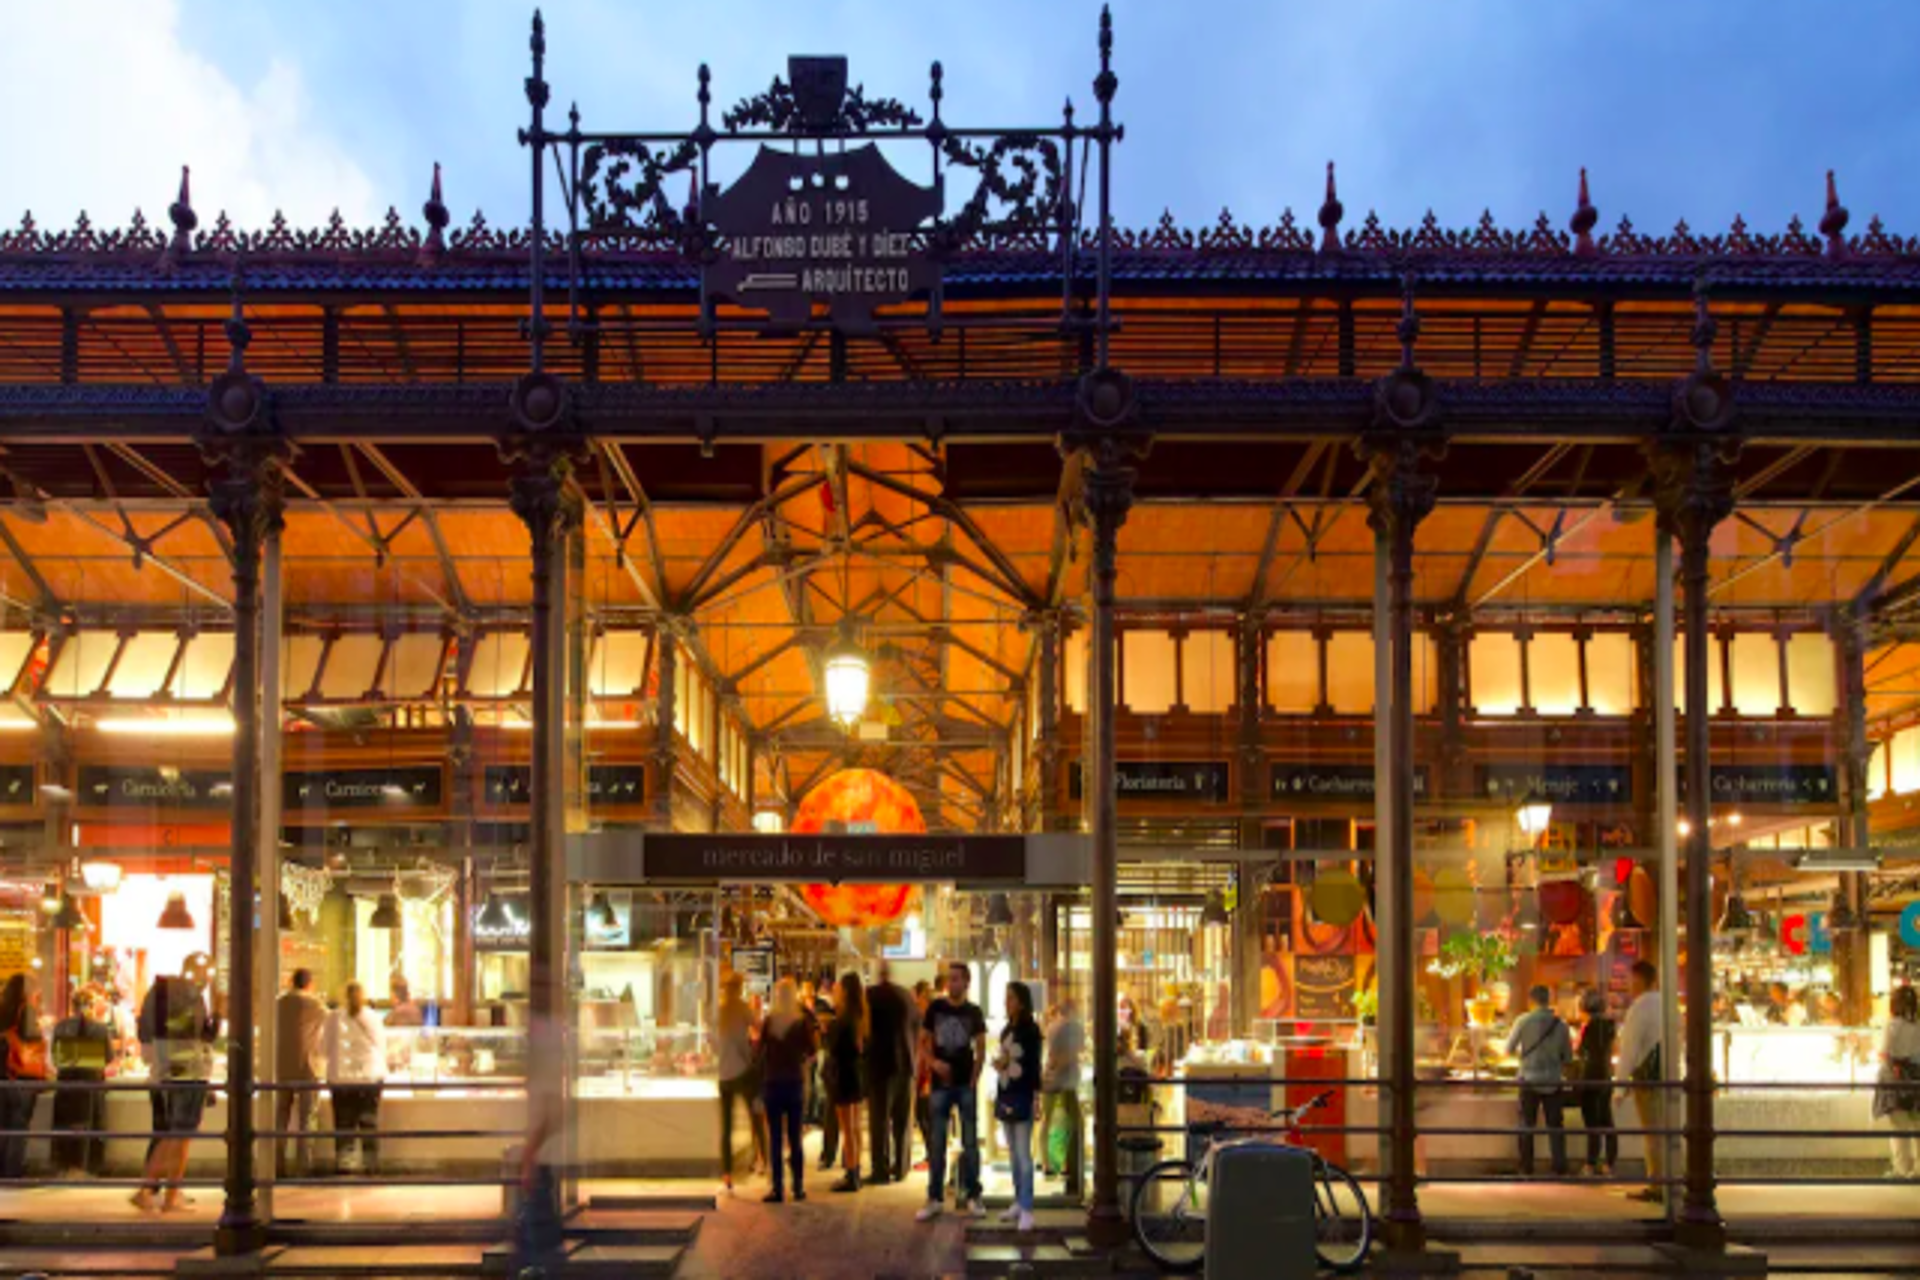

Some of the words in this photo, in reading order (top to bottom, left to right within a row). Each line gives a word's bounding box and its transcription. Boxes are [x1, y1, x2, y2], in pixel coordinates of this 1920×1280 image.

[771, 196, 811, 225] AÑO
[825, 198, 869, 224] 1915
[732, 235, 807, 260] ALFONSO
[859, 234, 867, 258] Y
[702, 840, 804, 868] mercado
[809, 840, 837, 868] de
[842, 849, 882, 869] san
[887, 841, 967, 874] miguel
